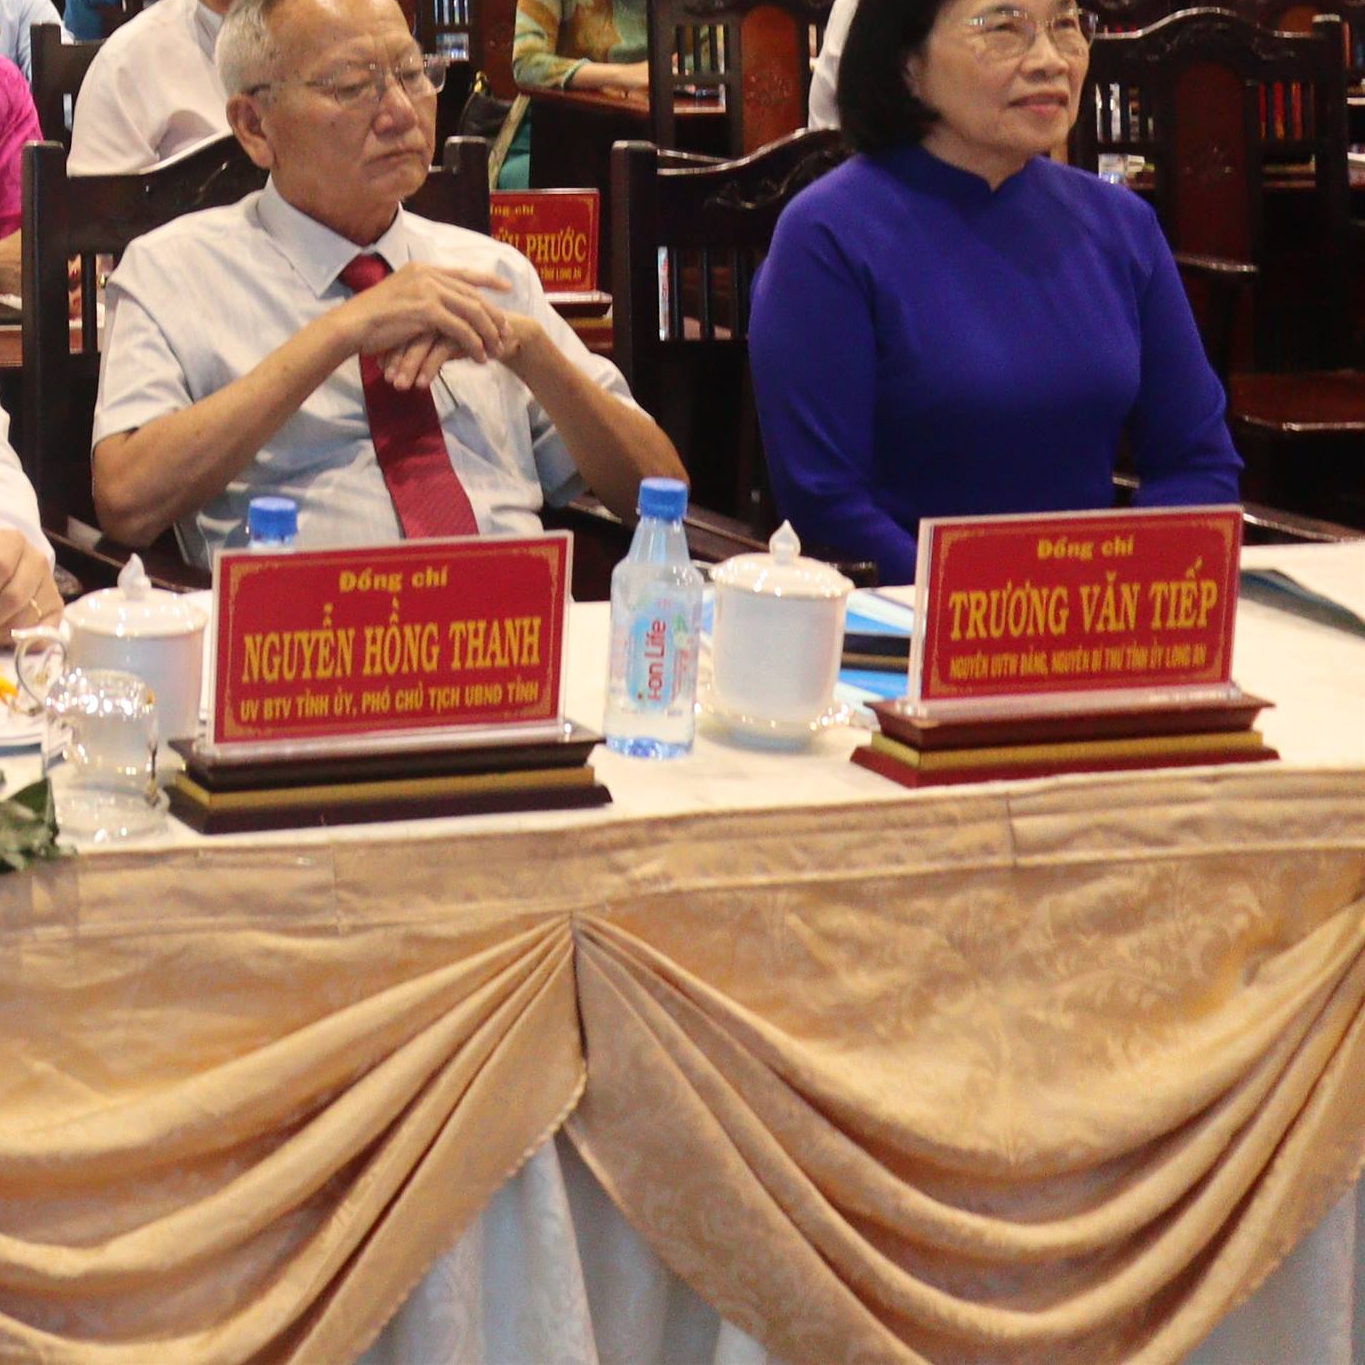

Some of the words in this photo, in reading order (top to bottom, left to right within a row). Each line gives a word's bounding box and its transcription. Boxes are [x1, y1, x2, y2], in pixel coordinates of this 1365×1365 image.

[526, 224, 587, 264] PHƯỚC
[1038, 536, 1093, 561] Đồng
[1102, 535, 1134, 557] chí
[339, 568, 403, 595] Đồng
[412, 568, 448, 589] chí
[948, 579, 1069, 641] TRƯƠNG
[1080, 573, 1141, 632] VĂN
[1150, 558, 1219, 629] TIẾP
[242, 603, 353, 685] NGUYỄN
[363, 598, 440, 675] HỒNG
[449, 616, 541, 669] THANH
[240, 698, 258, 721] UV
[296, 688, 329, 717] TỈNH
[362, 686, 391, 713] PHÓ
[395, 681, 424, 712] CHỦ
[429, 687, 460, 714] TỊCH
[465, 684, 502, 705] UBND
[507, 676, 539, 703] TỈNH
